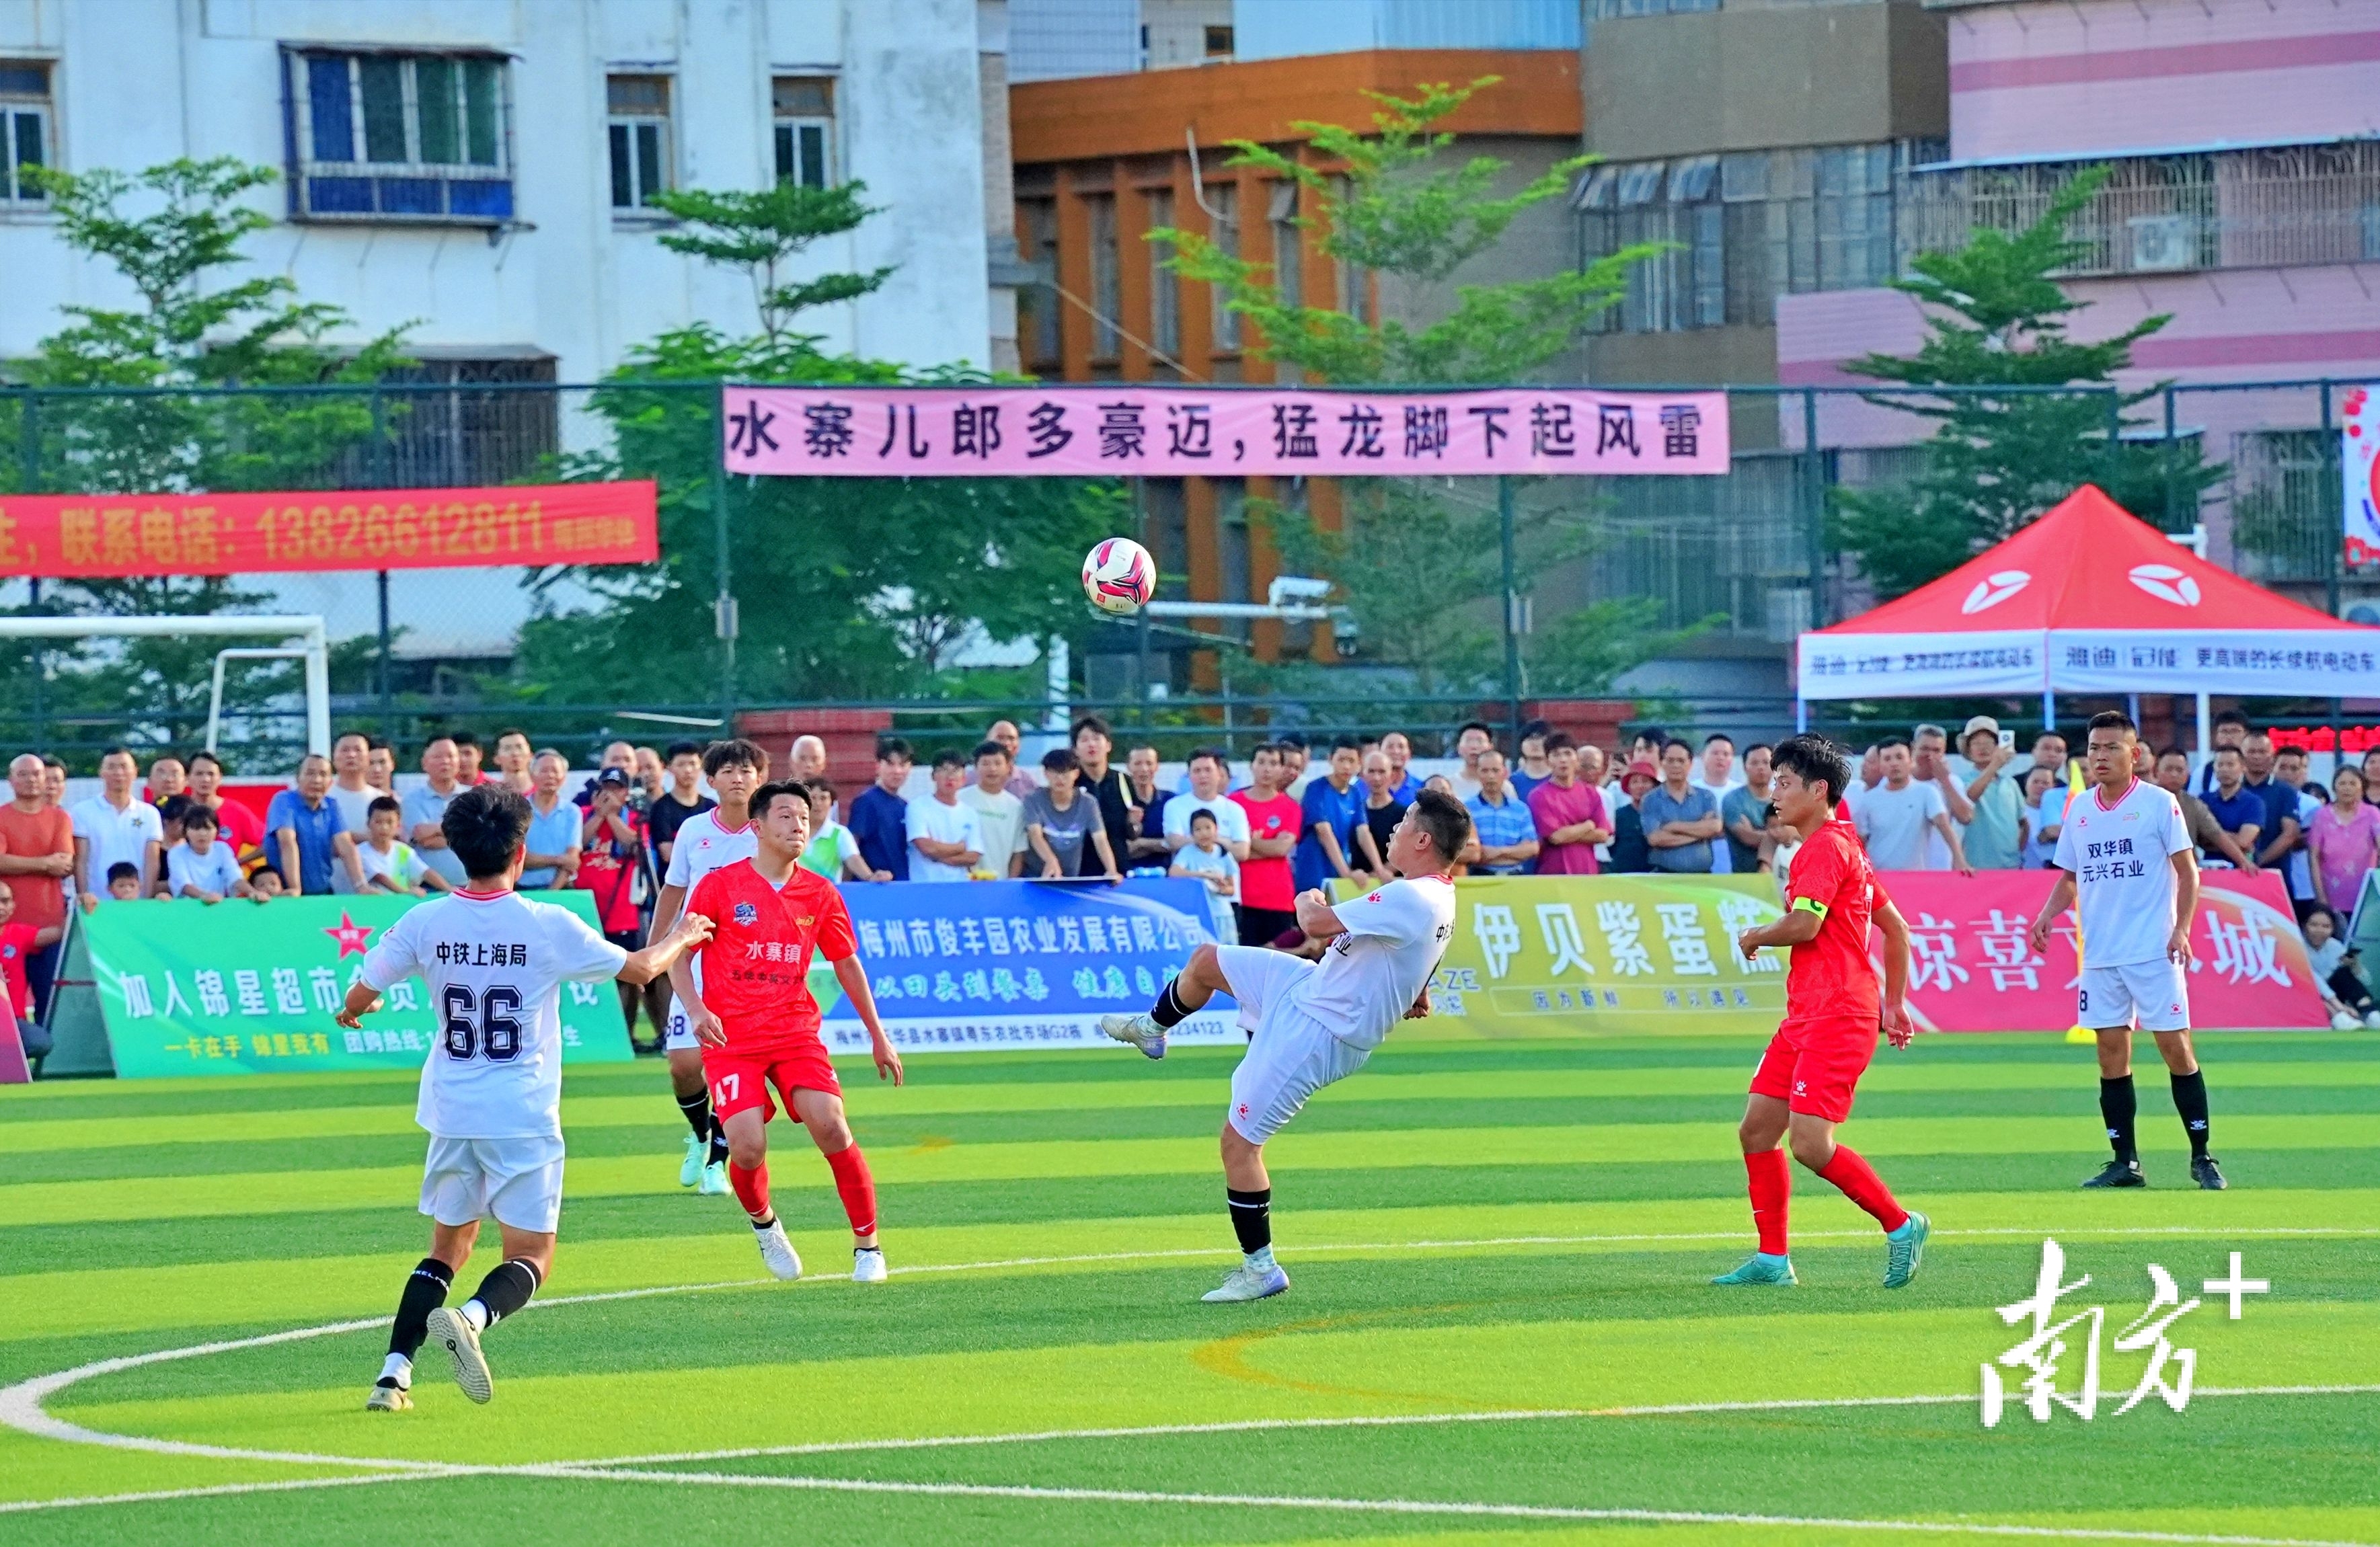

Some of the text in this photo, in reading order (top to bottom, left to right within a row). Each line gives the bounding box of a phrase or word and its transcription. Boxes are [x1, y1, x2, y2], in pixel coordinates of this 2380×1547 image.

[2087, 838, 2133, 859] 双华镇
[2083, 860, 2145, 883] 元兴石业
[436, 942, 527, 967] 中铁上海局
[745, 940, 802, 965] 水寨镇
[441, 982, 523, 1063] 66
[165, 1035, 241, 1059] 一卡在手
[715, 1073, 740, 1108] 47
